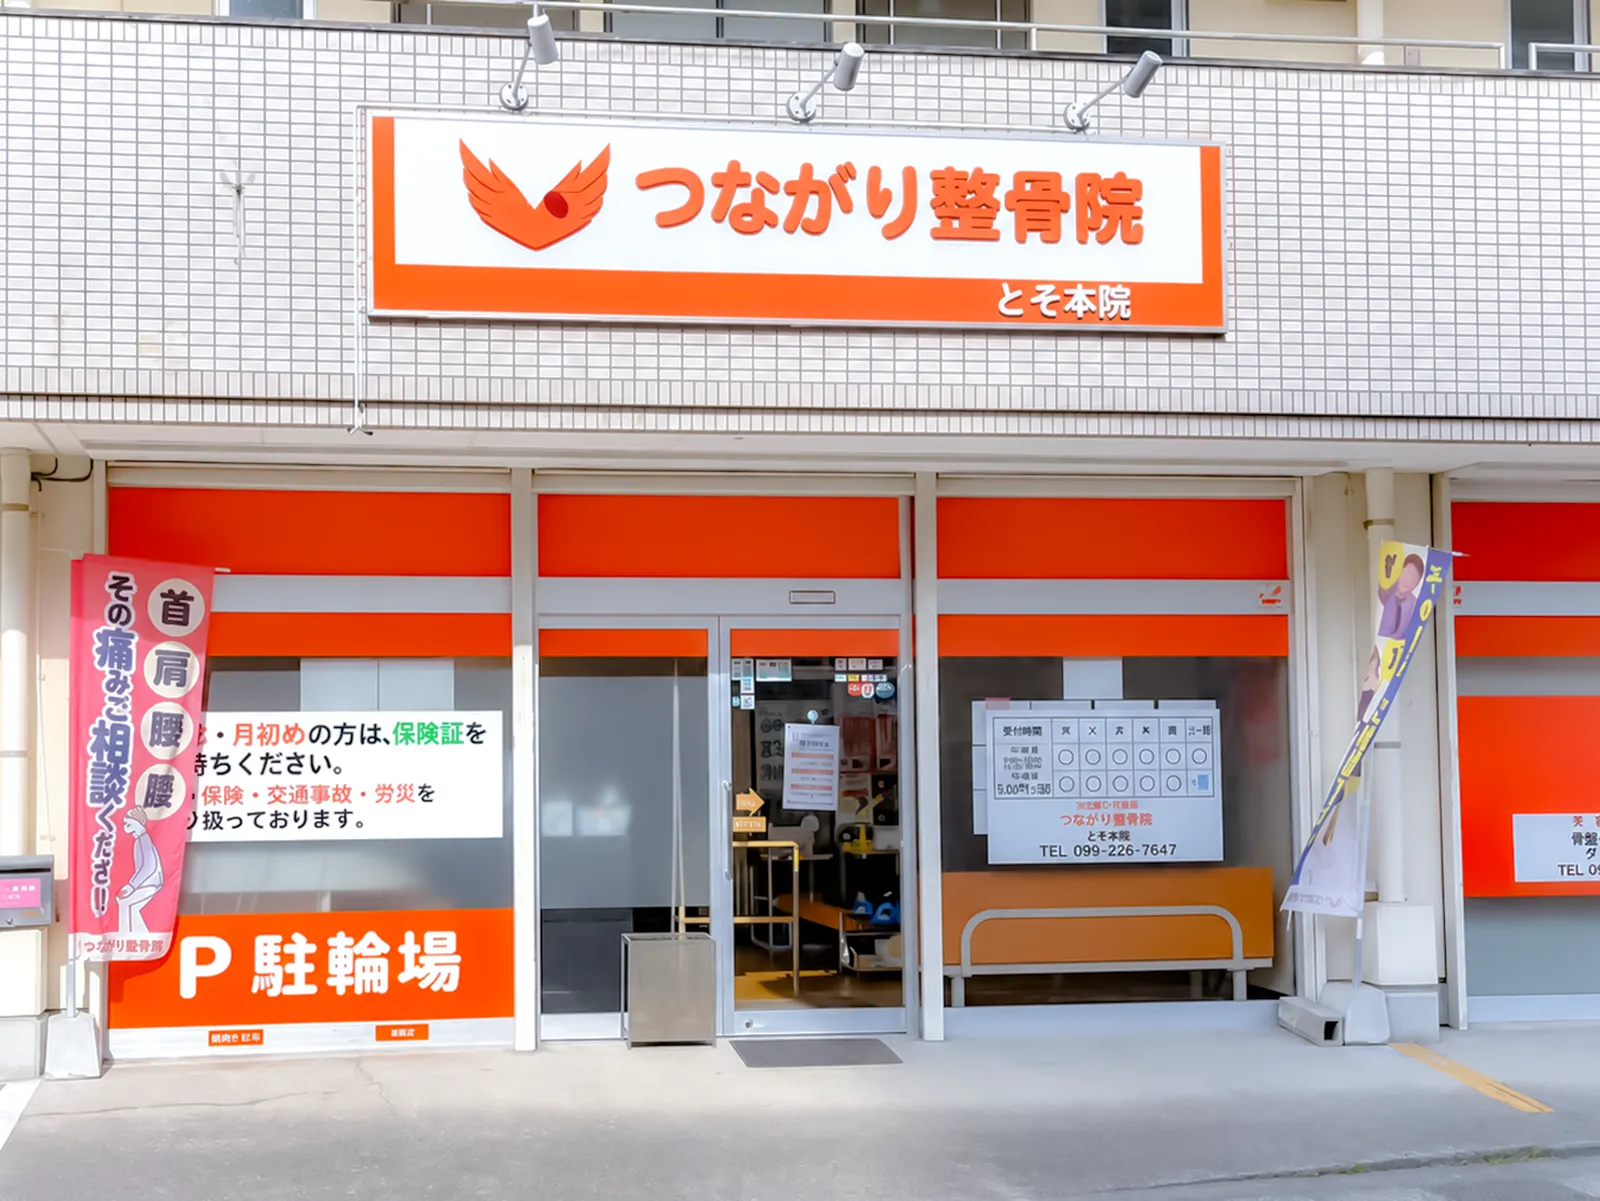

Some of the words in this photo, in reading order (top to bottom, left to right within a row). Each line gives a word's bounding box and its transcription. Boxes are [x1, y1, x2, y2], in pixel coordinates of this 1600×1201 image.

[635, 159, 1144, 245] つながり整骨院
[998, 282, 1132, 320] とそ本院
[160, 588, 195, 627] 首
[153, 649, 191, 688] 肩
[1040, 845, 1068, 857] TEL
[1073, 844, 1177, 858] 099-226-7647
[1558, 864, 1584, 876] TEL
[179, 936, 232, 999] P
[251, 931, 462, 997] 駐輪場
